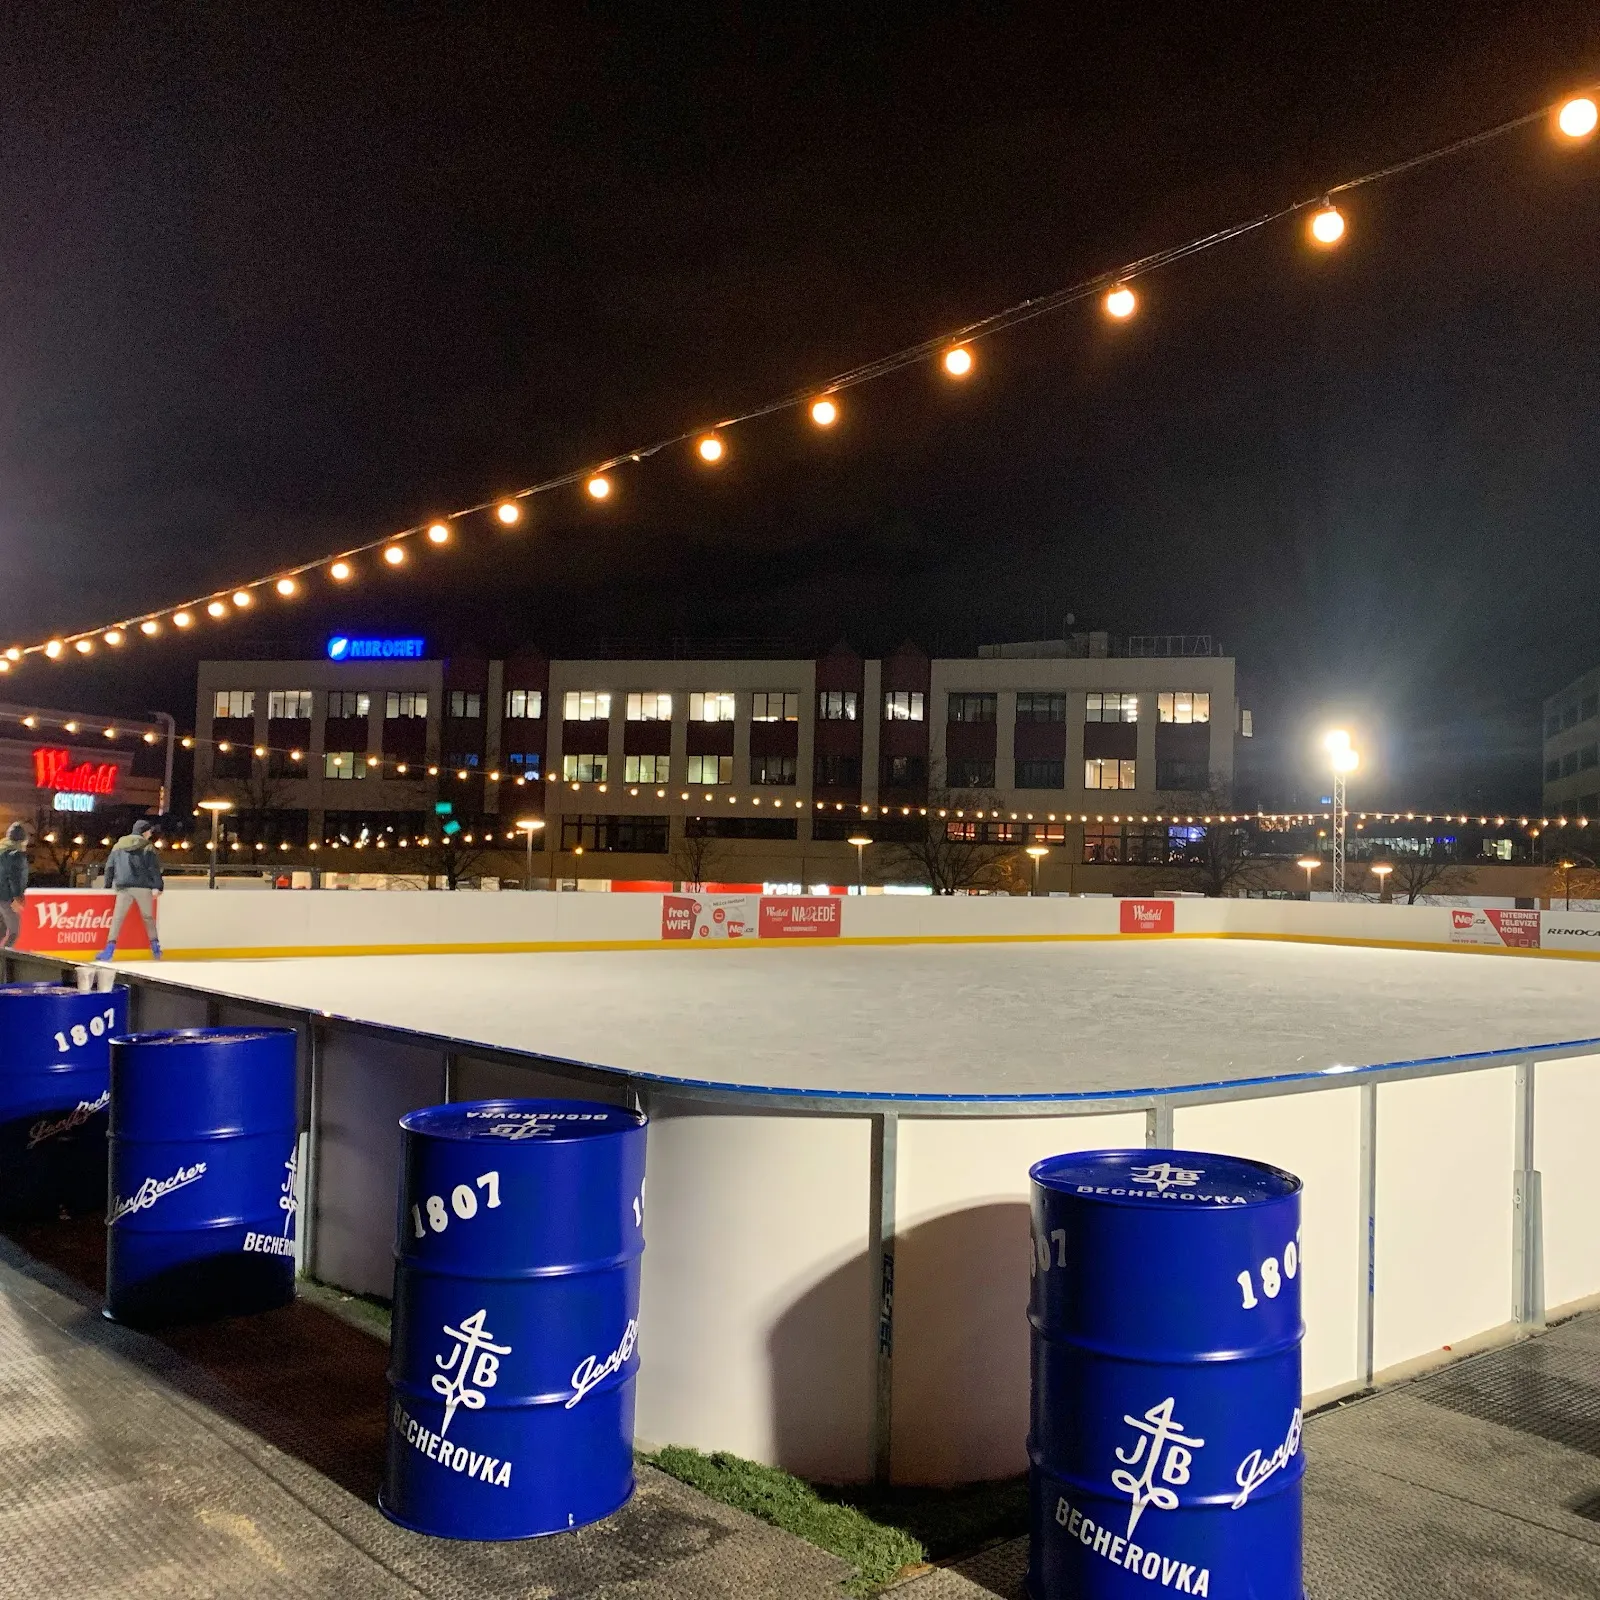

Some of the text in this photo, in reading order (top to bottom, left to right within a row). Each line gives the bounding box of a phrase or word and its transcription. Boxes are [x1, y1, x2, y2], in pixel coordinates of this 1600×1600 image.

[350, 640, 424, 657] MIRONET
[33, 749, 118, 794] Westfield
[668, 907, 690, 918] free
[1132, 904, 1163, 921] Westfield
[1500, 911, 1539, 920] INTERNET
[666, 919, 691, 931] WiFi
[1500, 919, 1538, 928] TELEVIZE
[1500, 927, 1525, 935] MOBIL
[57, 931, 97, 944] CHODOV
[54, 1008, 115, 1052] 1807
[1076, 1185, 1248, 1205] BECHEROVKA
[411, 1170, 502, 1239] 1807
[393, 1400, 512, 1488] BECHEROVKA
[1055, 1496, 1210, 1599] BECHEROVKA
